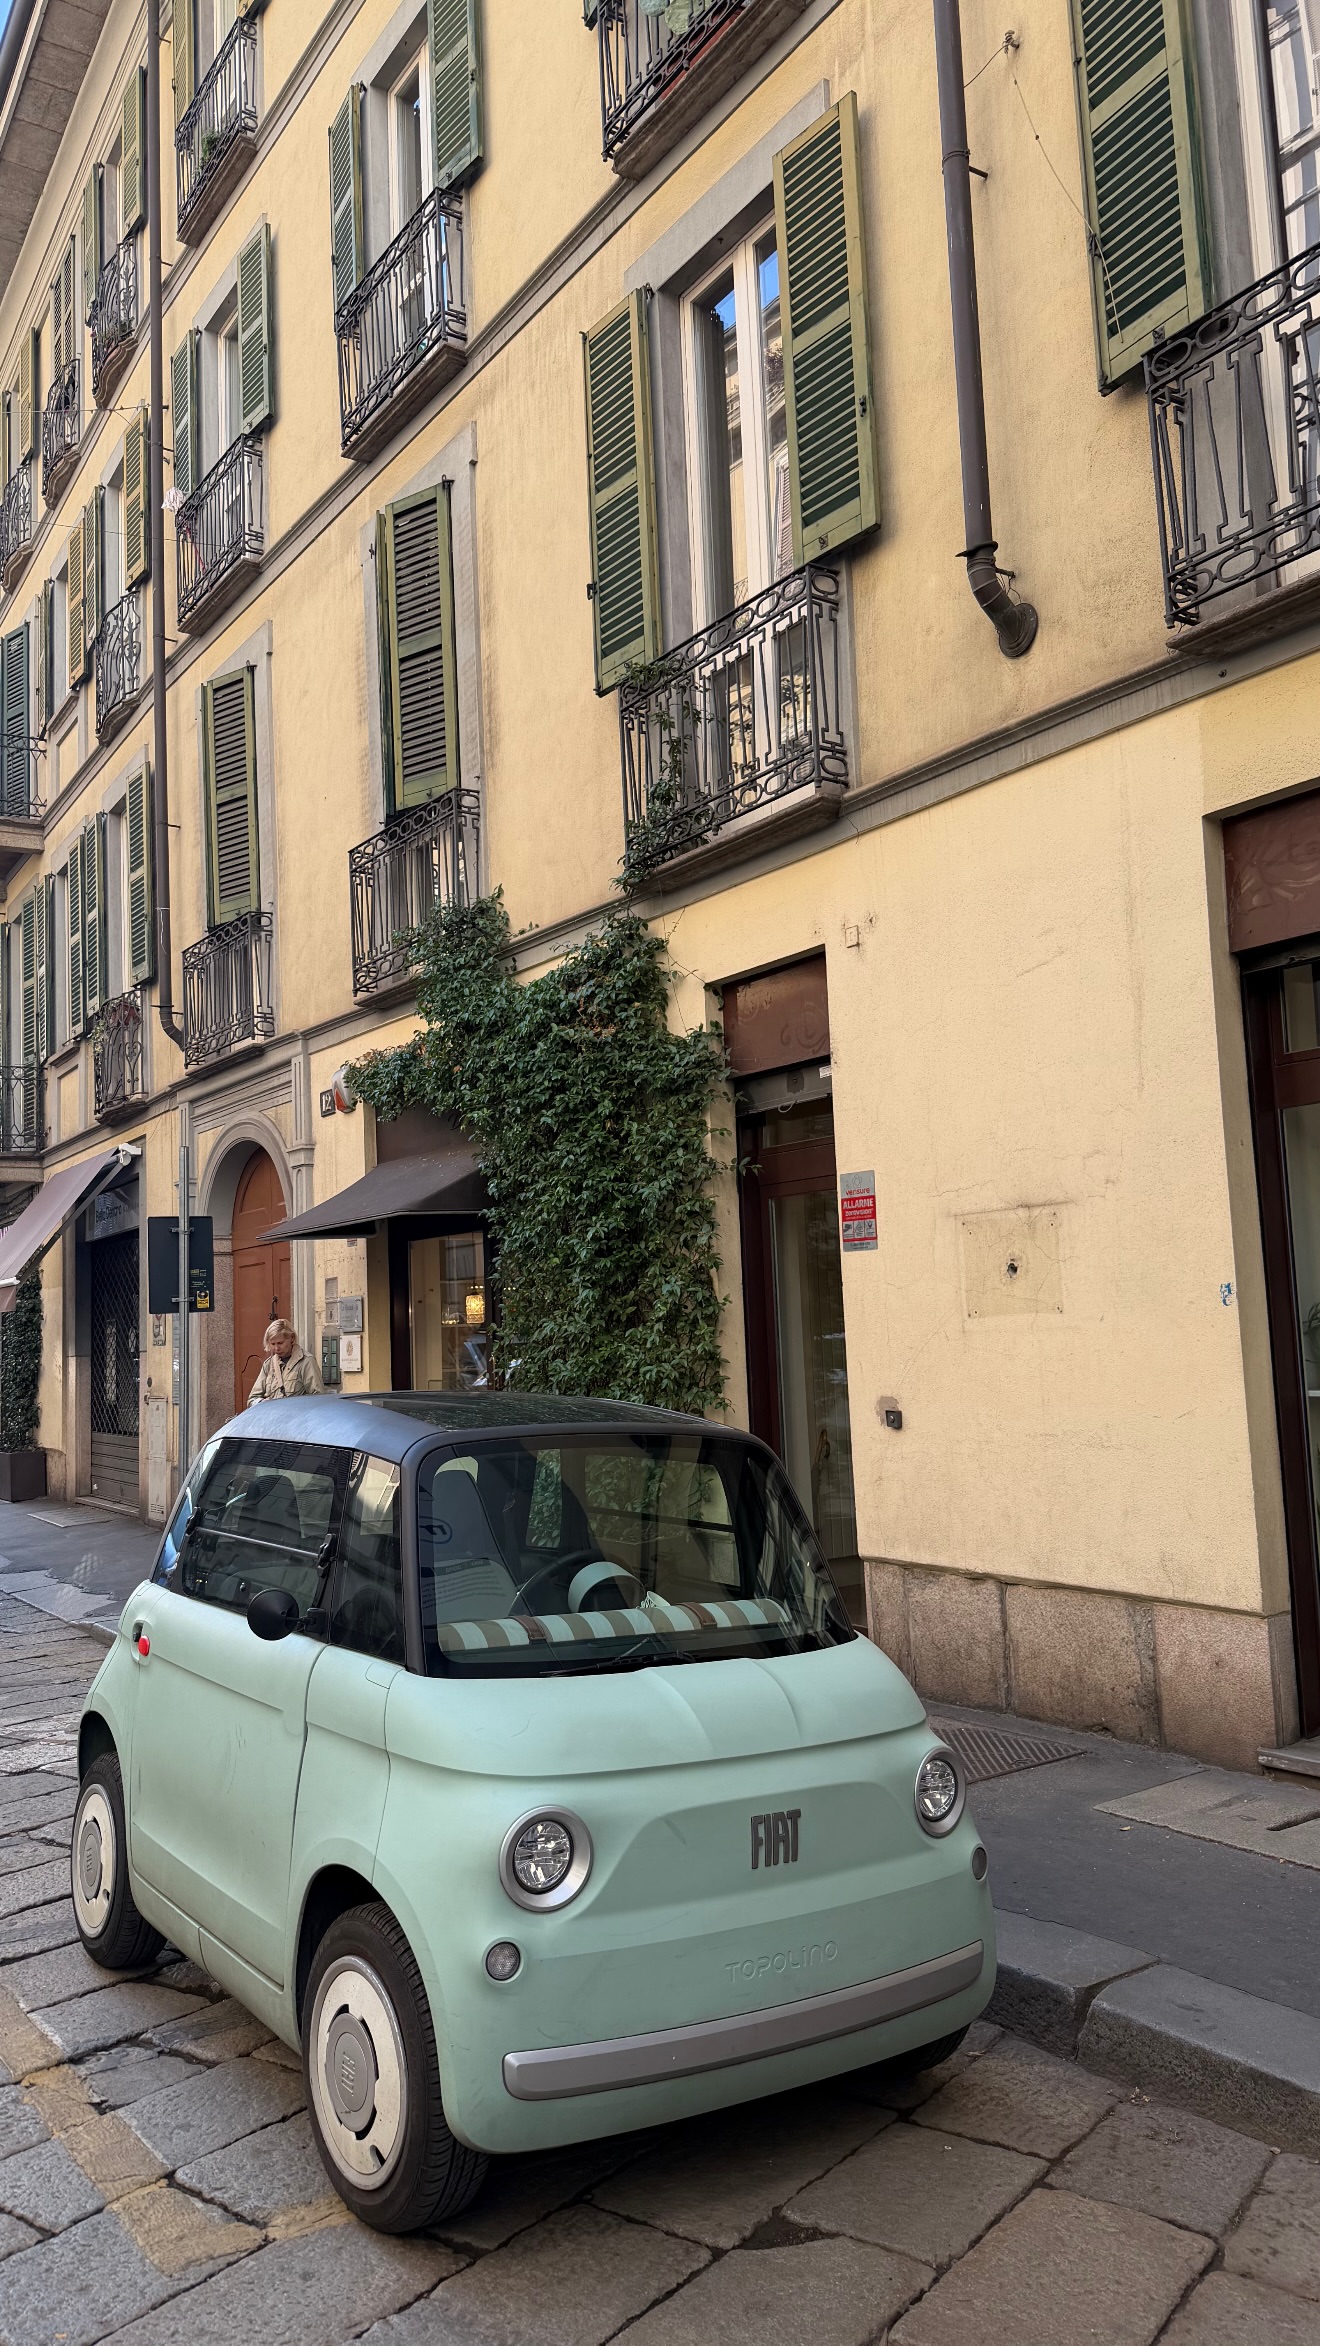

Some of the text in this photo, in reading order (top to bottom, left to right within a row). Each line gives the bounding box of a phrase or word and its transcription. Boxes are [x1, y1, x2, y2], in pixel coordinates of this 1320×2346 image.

[322, 1093, 332, 1112] 12
[843, 1198, 874, 1209] ALLARME
[751, 1809, 801, 1869] FIAT
